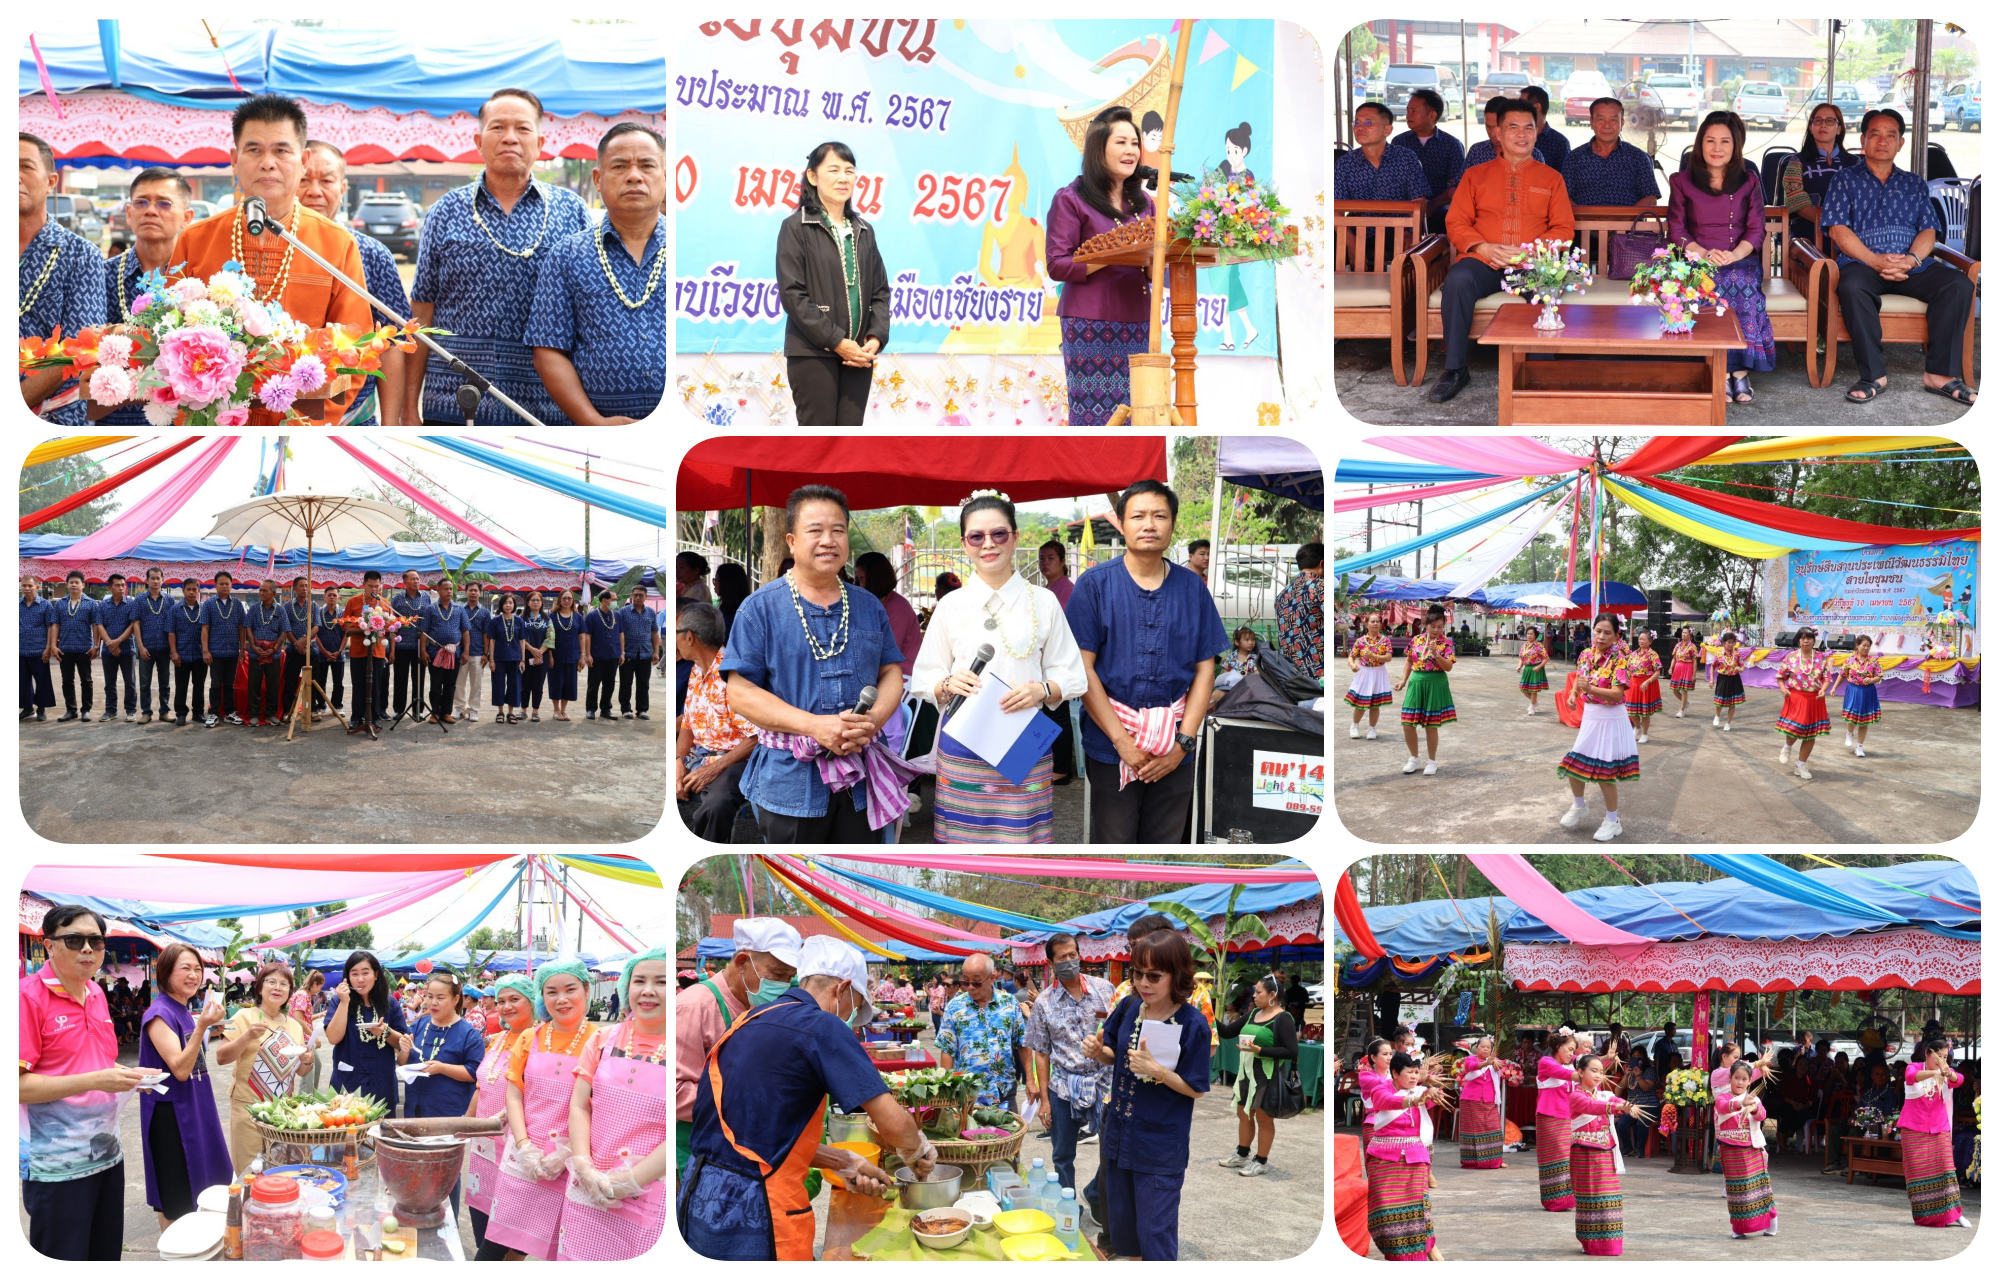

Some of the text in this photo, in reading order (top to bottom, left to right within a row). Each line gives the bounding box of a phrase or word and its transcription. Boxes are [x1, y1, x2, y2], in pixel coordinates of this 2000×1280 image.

[821, 91, 873, 124] พ.ศ.
[885, 94, 951, 131] 2567
[734, 166, 884, 215] เมษน
[913, 174, 1014, 222] 2567
[1846, 571, 1904, 588] สายใยชุมชน
[1856, 599, 1865, 607] 10
[1899, 598, 1917, 606] 2567
[1256, 778, 1284, 792] Light
[1287, 782, 1296, 792] &
